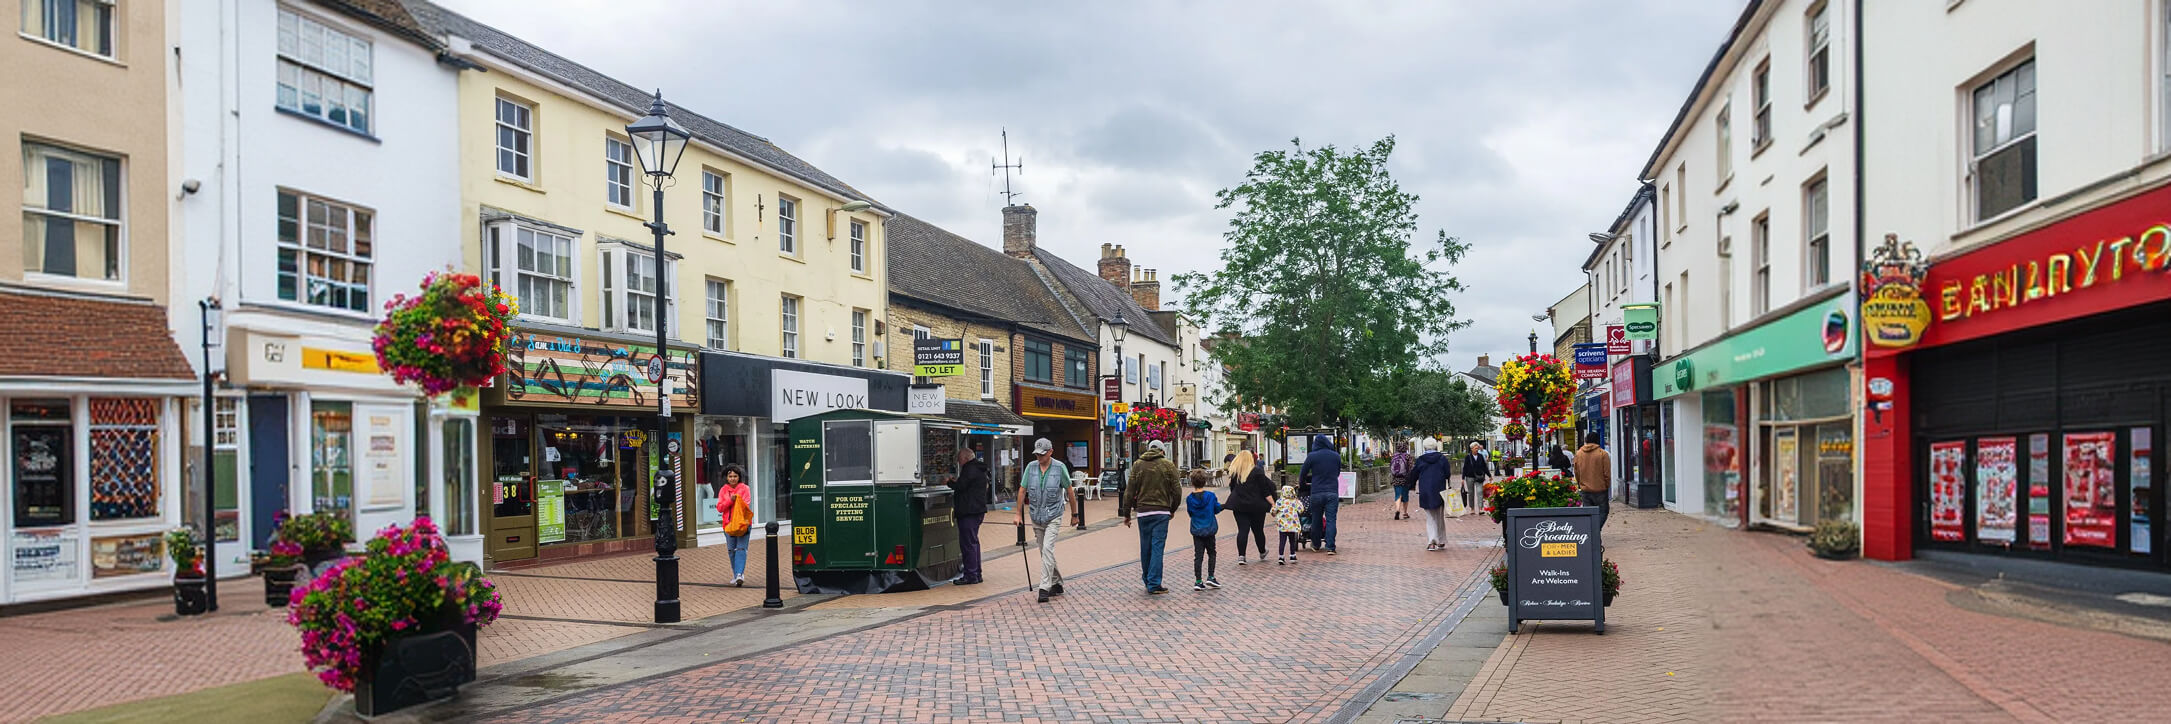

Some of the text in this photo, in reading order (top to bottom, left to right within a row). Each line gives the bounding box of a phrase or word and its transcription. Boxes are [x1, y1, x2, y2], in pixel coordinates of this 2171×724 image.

[1578, 355, 1605, 363] opticians
[939, 366, 955, 374] LET
[783, 388, 864, 408] NEW LOOK
[624, 429, 647, 441] TATTOO
[1536, 520, 1573, 534] Body
[1520, 527, 1589, 549] Grooming
